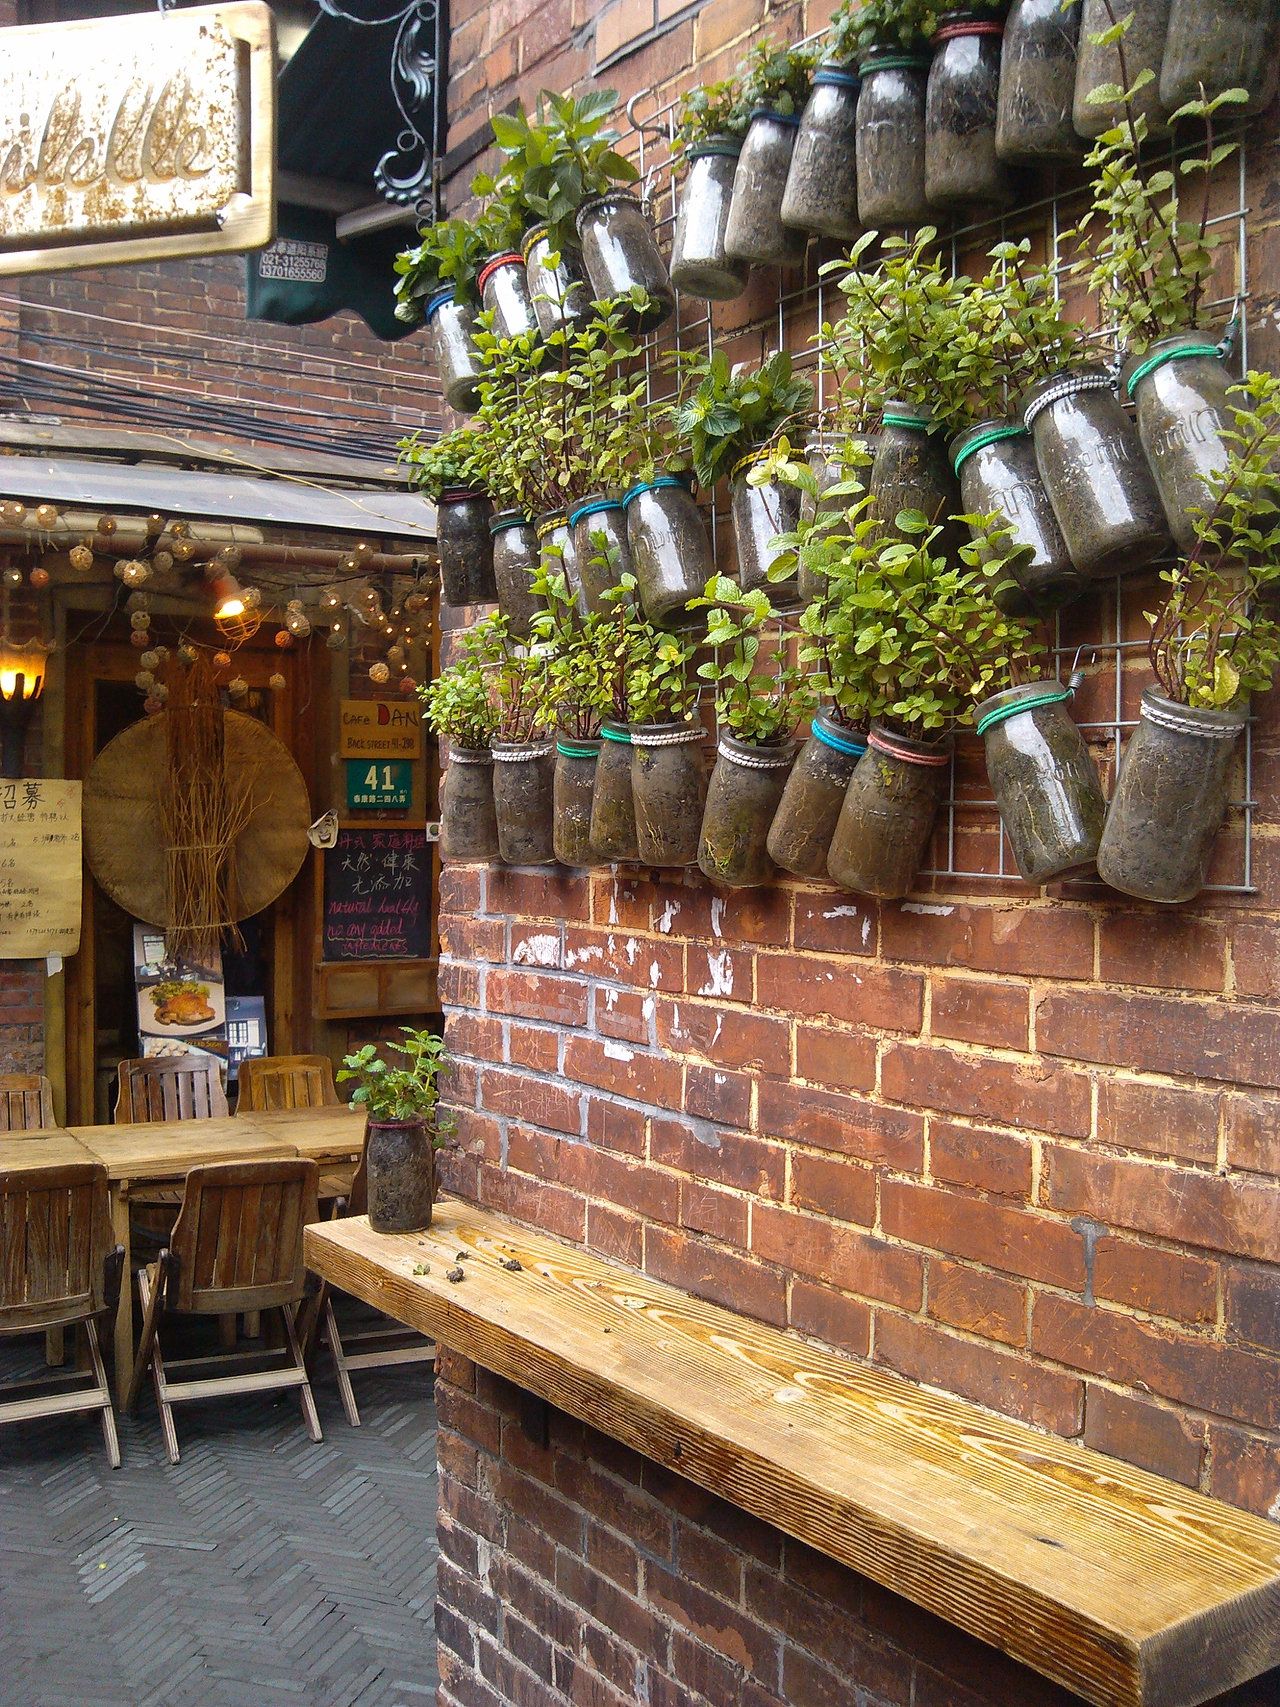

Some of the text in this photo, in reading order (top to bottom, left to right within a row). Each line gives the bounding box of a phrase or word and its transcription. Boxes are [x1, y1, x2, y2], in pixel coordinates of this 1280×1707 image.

[262, 264, 323, 280] 13701655560
[376, 703, 419, 728] DAN
[366, 739, 390, 750] STREET
[364, 765, 395, 790] 41
[328, 897, 373, 915] natural
